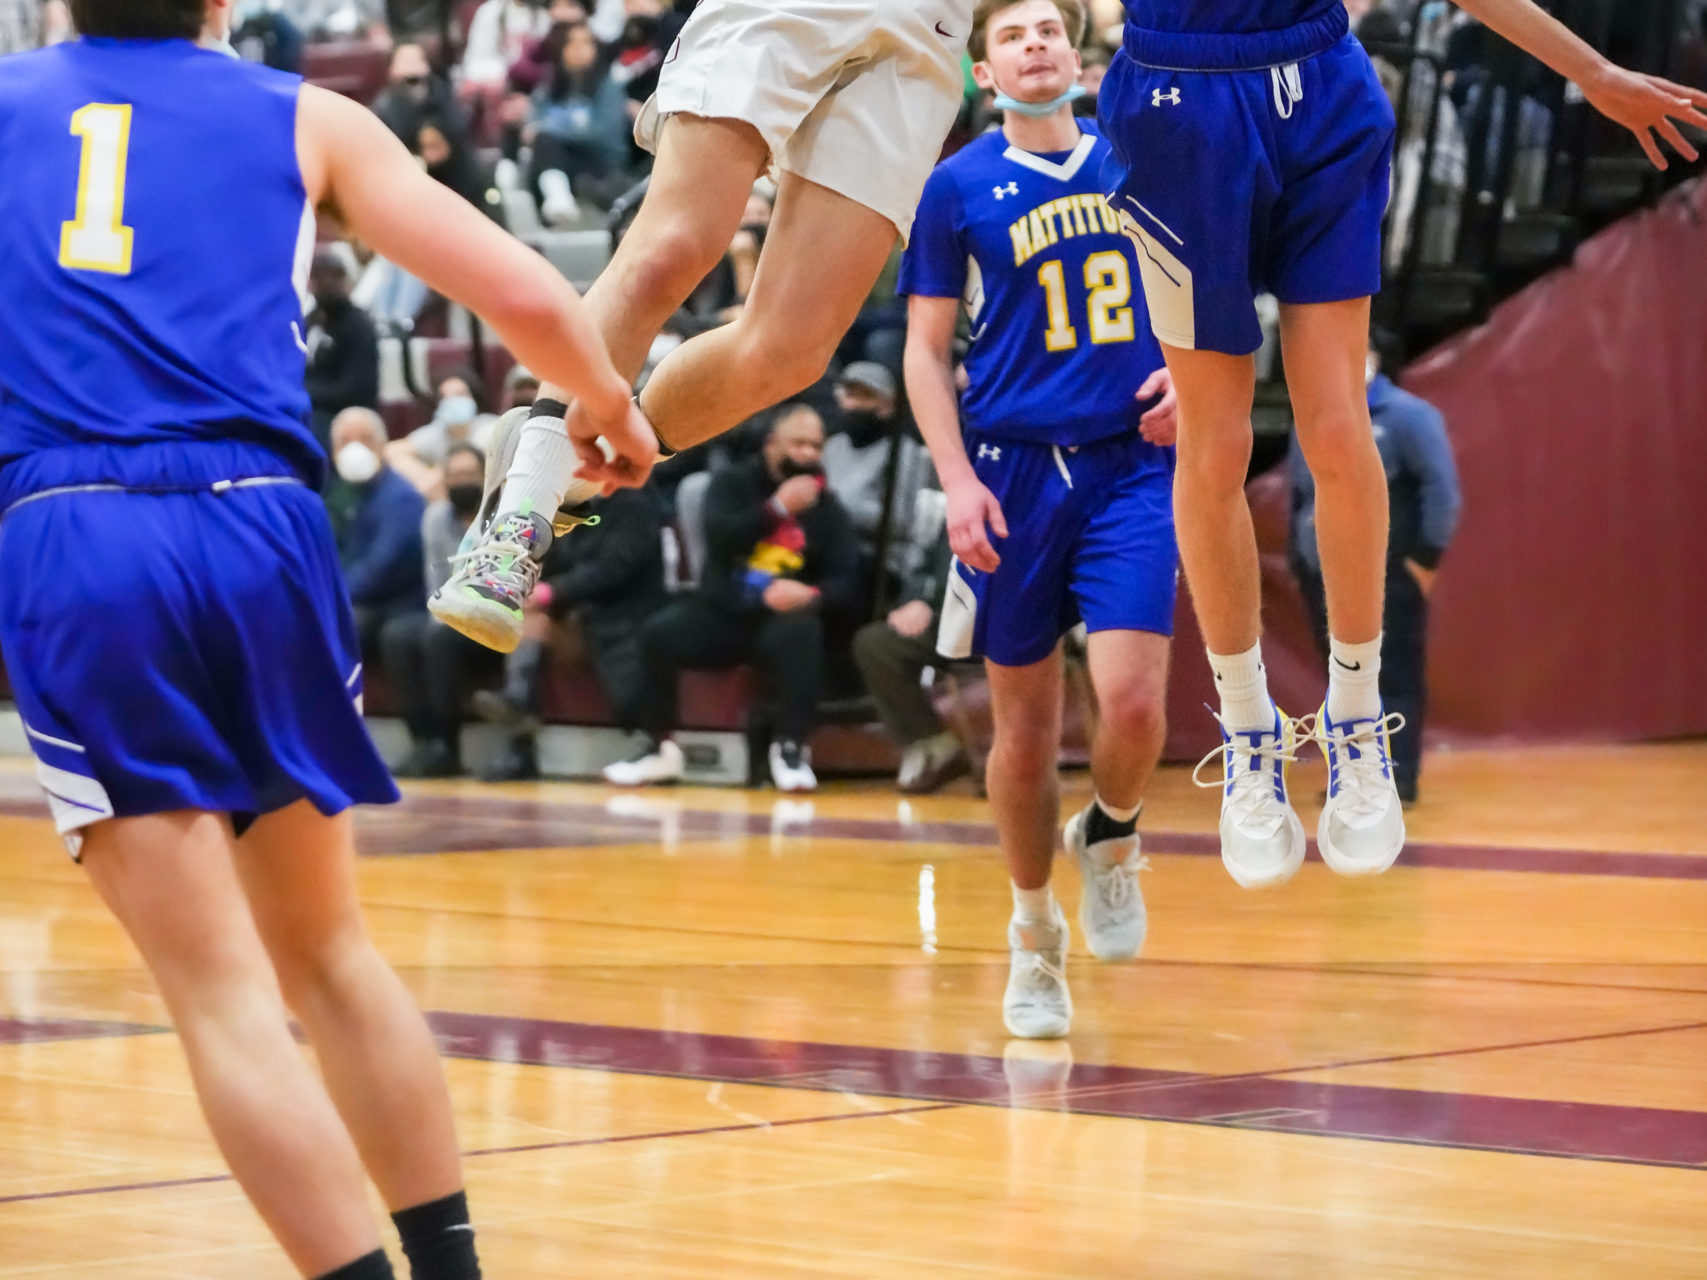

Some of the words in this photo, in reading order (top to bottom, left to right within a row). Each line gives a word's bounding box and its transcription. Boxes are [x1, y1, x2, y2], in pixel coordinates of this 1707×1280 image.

[58, 102, 134, 276] 1
[1008, 193, 1121, 267] MATTITU
[1037, 250, 1135, 351] 12
